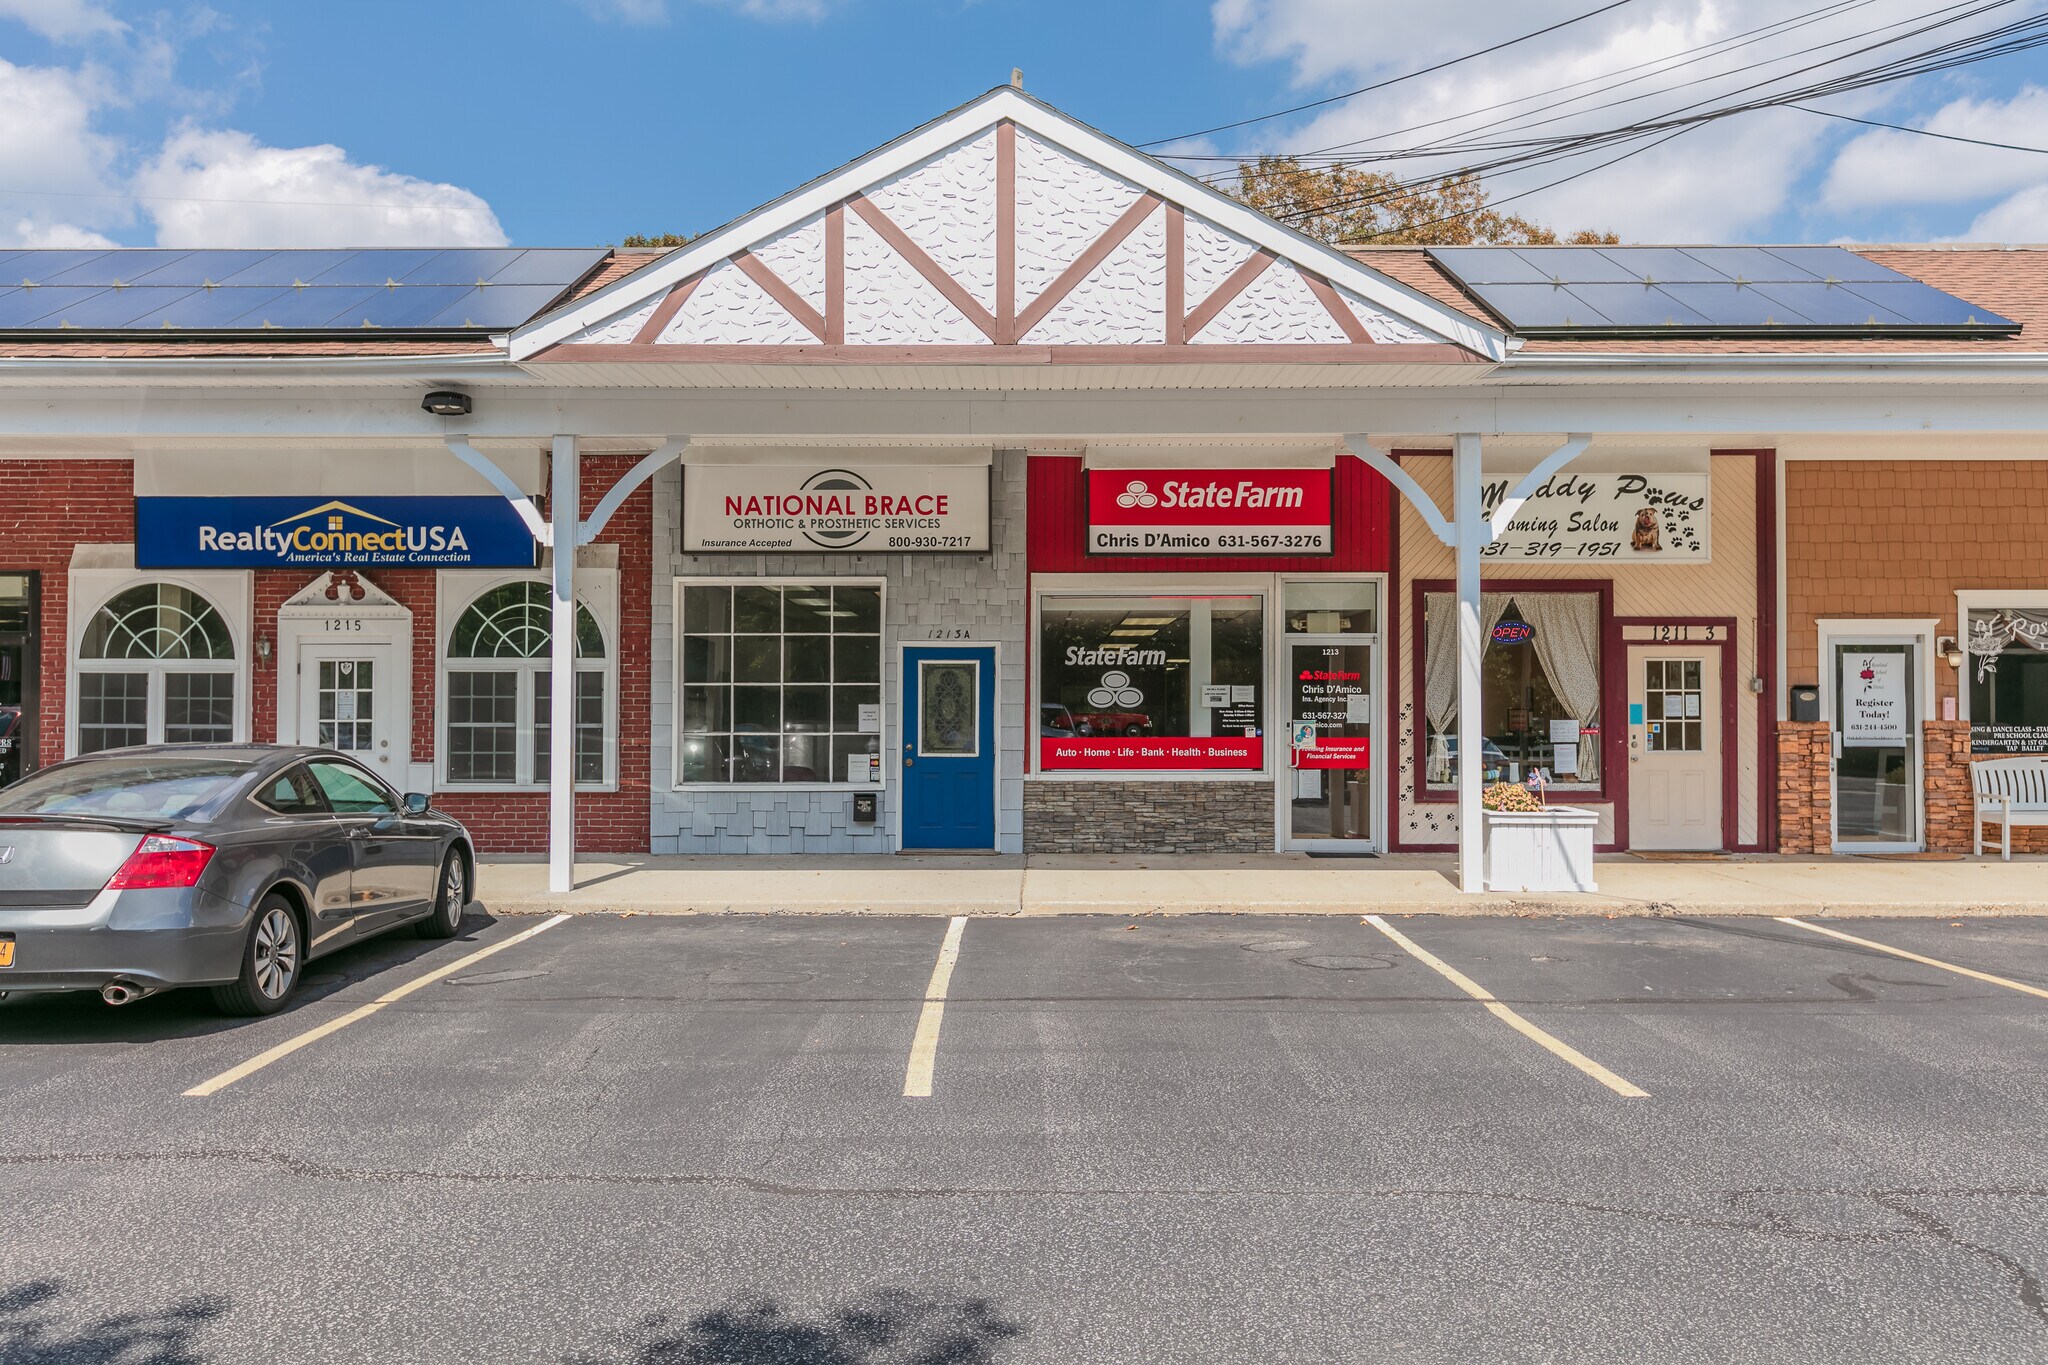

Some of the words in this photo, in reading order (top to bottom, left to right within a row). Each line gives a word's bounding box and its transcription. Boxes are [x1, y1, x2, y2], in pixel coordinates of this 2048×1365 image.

[1481, 475, 1595, 508] Mddy
[725, 495, 856, 516] NATIONAL
[865, 495, 948, 516] BRACE
[733, 518, 794, 529] ORTHOTIC
[798, 518, 806, 529] &
[810, 518, 881, 529] PROSTHETIC
[885, 518, 941, 529] SERVICES
[1566, 511, 1619, 532] Salon
[701, 539, 747, 548] Insurance
[749, 539, 792, 549] Accepted
[888, 536, 971, 547] 800-930-7217
[1096, 533, 1139, 548] Chris
[1144, 533, 1210, 548] D'Amico
[1218, 535, 1322, 548] 631-567-3276
[286, 552, 341, 563] America's
[344, 552, 369, 562] Real
[372, 552, 405, 562] Estate
[408, 552, 471, 562] Connection
[325, 620, 361, 631] 1215
[1492, 627, 1530, 638] OPEN
[1653, 625, 1688, 640] 1211
[1705, 625, 1715, 640] 3
[1322, 648, 1339, 656] 1213
[1302, 685, 1324, 694] Chris
[1326, 685, 1362, 694] D'Amico
[1314, 696, 1336, 704] Agency
[1856, 698, 1894, 708] Register
[1859, 710, 1890, 720] Today!
[1056, 748, 1076, 757] Auto
[1084, 748, 1110, 757] Home
[1117, 748, 1134, 757] Life
[1141, 748, 1164, 757] Bank
[1172, 748, 1200, 757] Health
[1208, 748, 1248, 757] Business
